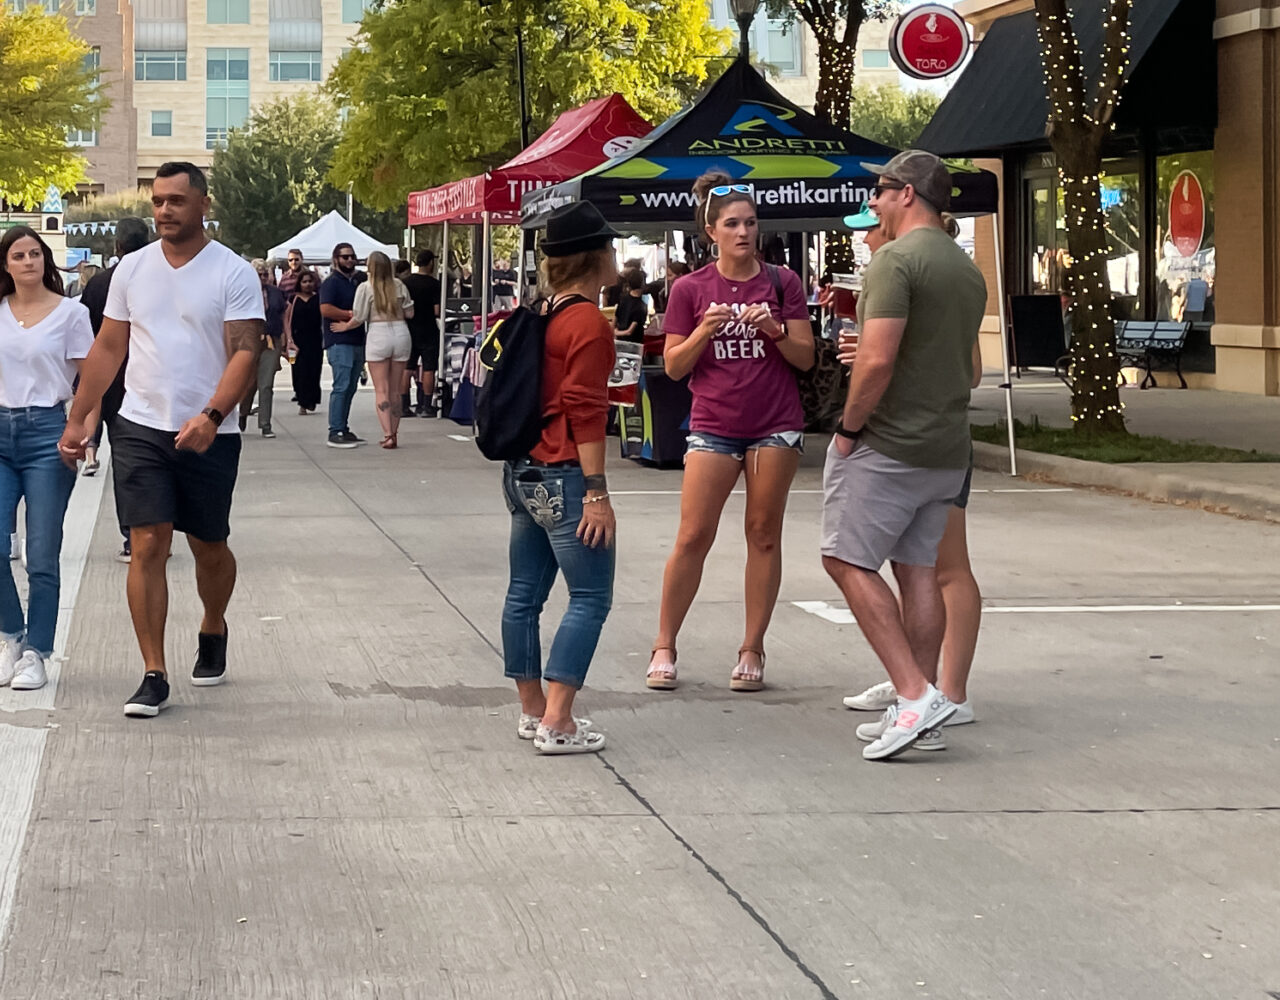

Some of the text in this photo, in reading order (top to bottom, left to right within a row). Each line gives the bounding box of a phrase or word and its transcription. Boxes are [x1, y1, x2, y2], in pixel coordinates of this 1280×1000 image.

[915, 58, 947, 70] TORO
[688, 138, 846, 150] ANDRETTI
[713, 339, 766, 360] BEER
